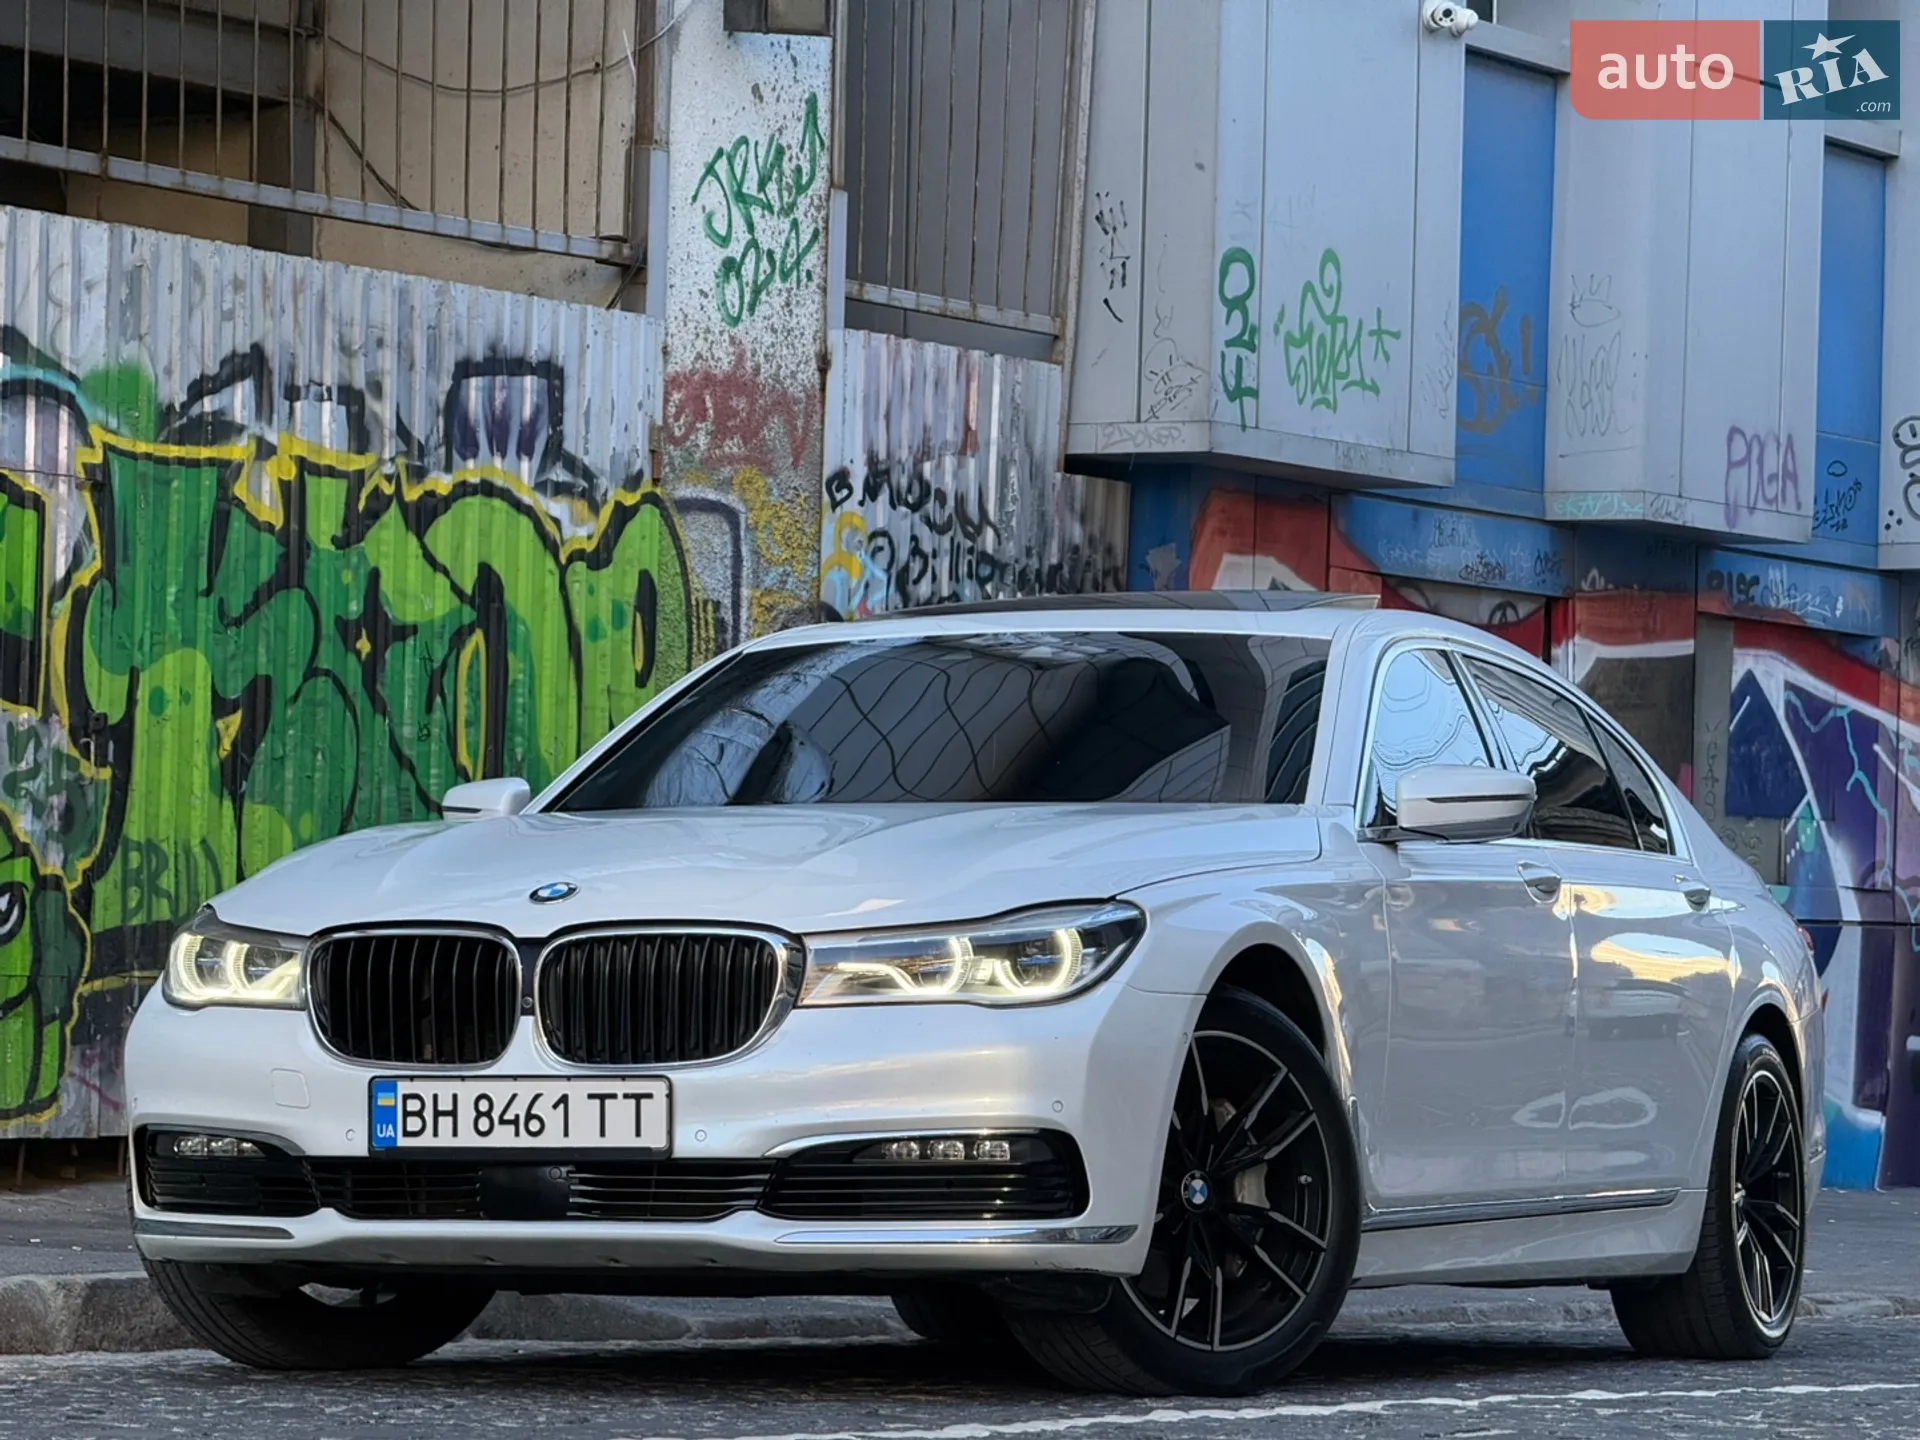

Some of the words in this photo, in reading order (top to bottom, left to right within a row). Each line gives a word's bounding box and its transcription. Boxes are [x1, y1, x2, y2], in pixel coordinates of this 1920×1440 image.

[401, 1092, 459, 1138] BH
[472, 1092, 570, 1138] 8461
[586, 1092, 654, 1138] TT
[376, 1123, 396, 1138] UA
